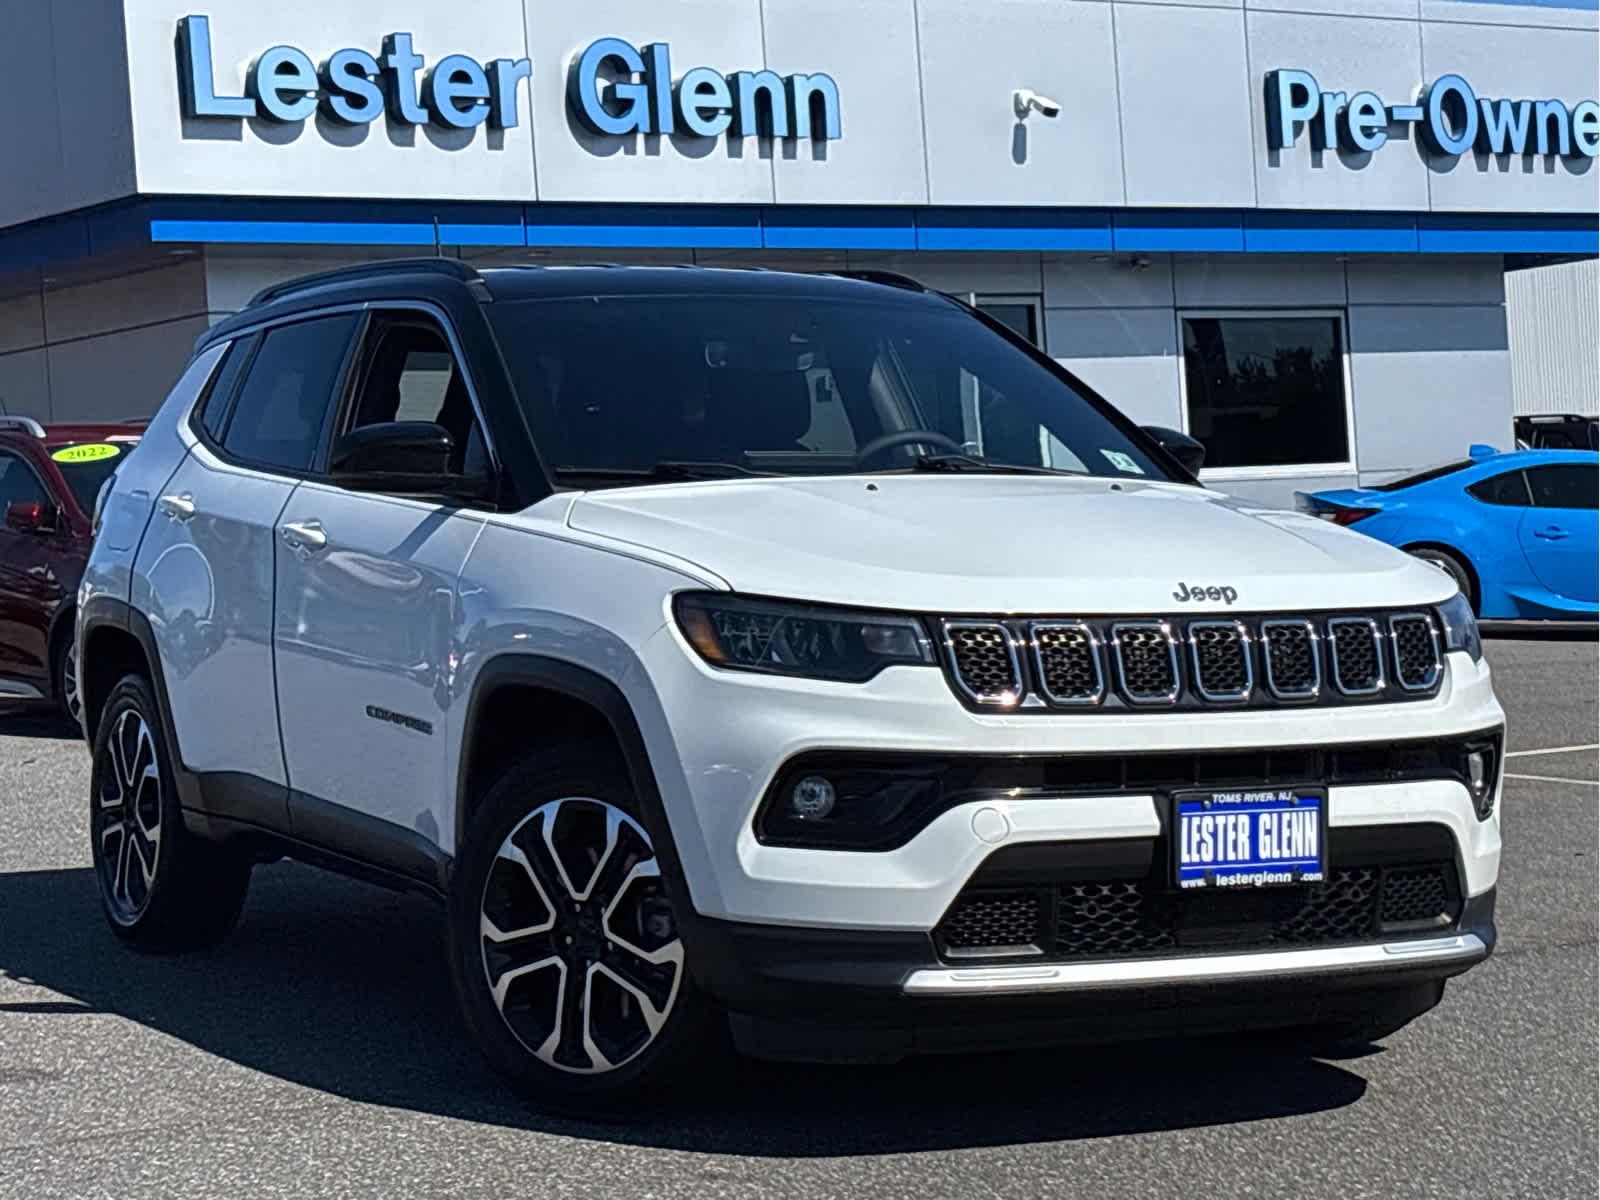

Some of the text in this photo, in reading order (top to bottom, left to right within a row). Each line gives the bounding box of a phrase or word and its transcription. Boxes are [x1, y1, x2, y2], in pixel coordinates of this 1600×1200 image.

[177, 15, 841, 139] Lester Glenn
[66, 446, 108, 460] 2022
[1172, 582, 1238, 605] Jeep
[1212, 793, 1242, 803] TOMS
[1180, 811, 1318, 863] LESTER GLENN
[1216, 871, 1292, 886] lesterglenn
[1300, 872, 1323, 881] .com
